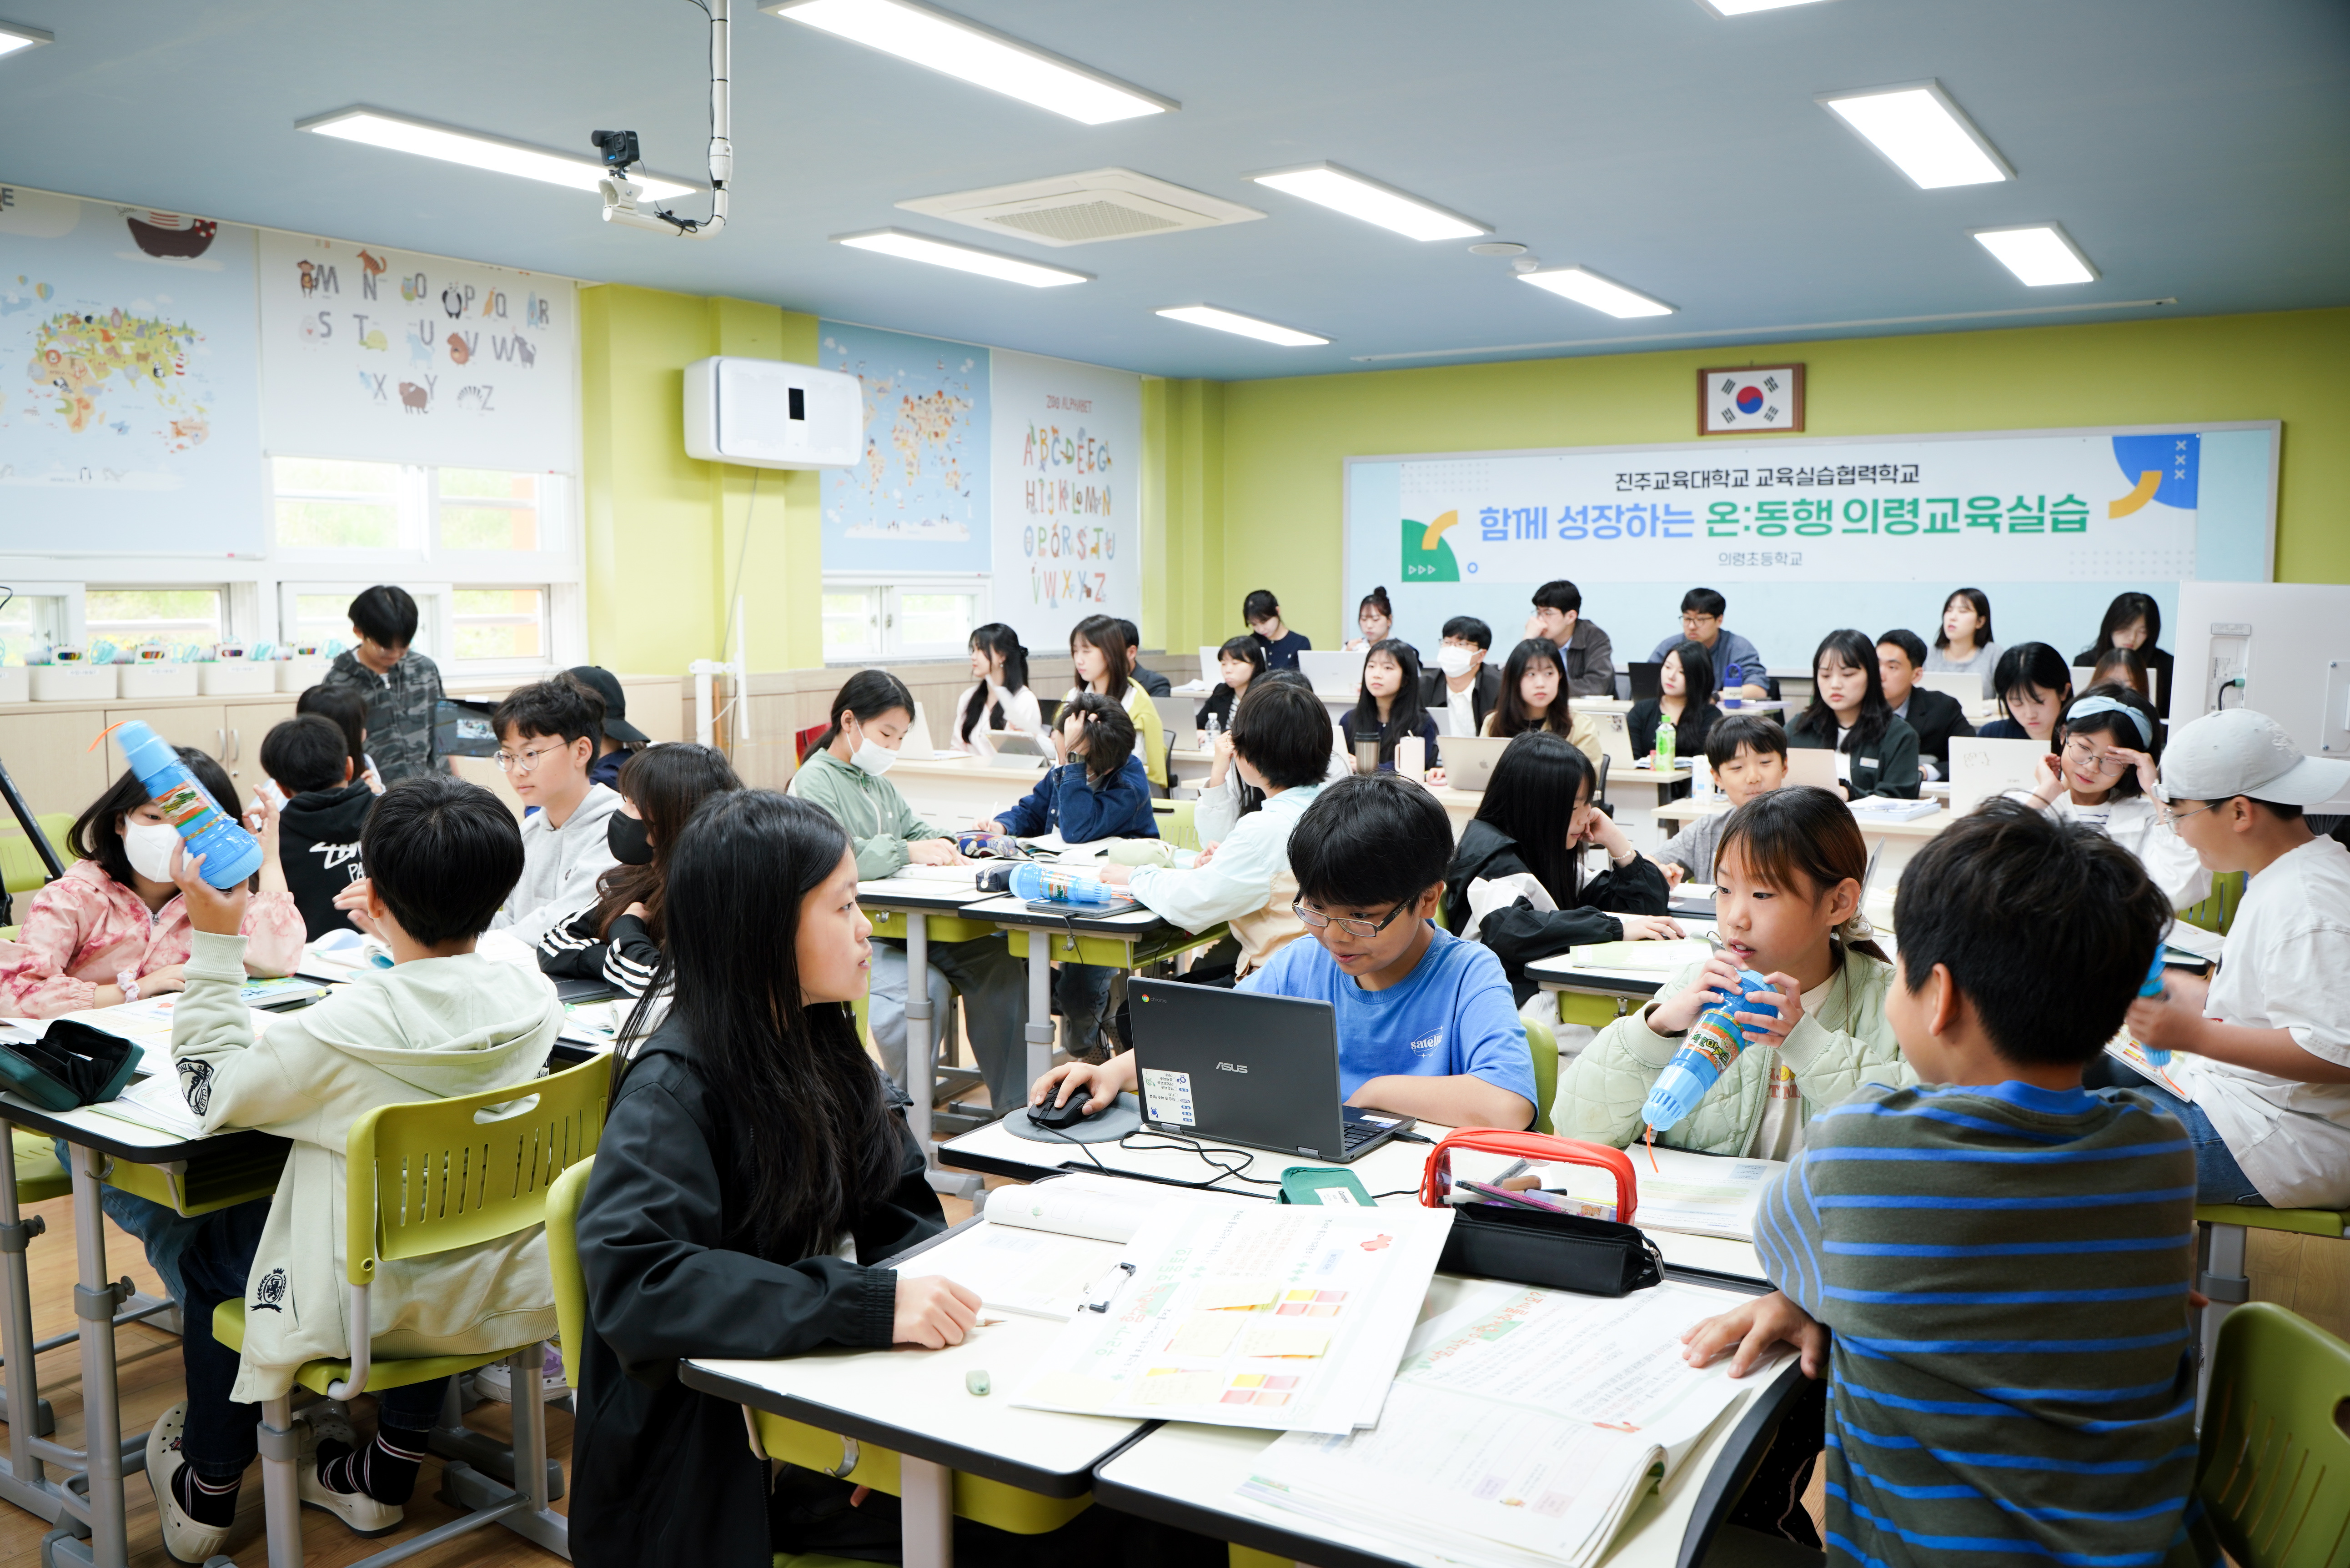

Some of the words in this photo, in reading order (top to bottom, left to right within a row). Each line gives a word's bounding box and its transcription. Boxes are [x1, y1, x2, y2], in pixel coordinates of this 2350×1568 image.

[2, 188, 14, 207] E
[314, 265, 340, 294] M
[364, 272, 377, 301] N
[465, 285, 476, 310] P
[496, 293, 508, 318] Q
[539, 299, 549, 324] R
[318, 312, 332, 338] S
[353, 314, 369, 341] T
[420, 320, 434, 346] U
[465, 331, 479, 357] V
[492, 335, 516, 362] W
[373, 373, 387, 401] X
[425, 374, 438, 400] Y
[481, 385, 495, 411] Z
[1615, 468, 1750, 492] 진주교육대학교
[1756, 463, 1920, 488] 교육실습협력학교
[1479, 506, 1547, 541] 함께
[1557, 503, 1695, 540] 성장하는
[1706, 498, 1833, 537] 온:동행
[1842, 493, 2090, 536] 의령교육실습
[1718, 552, 1803, 567] 의령초등학교
[1215, 1061, 1248, 1074] ASUS
[1338, 1191, 1350, 1203] Campus
[1095, 1326, 1127, 1355] 우리가
[1120, 1287, 1165, 1321] 함께하는
[1157, 1247, 1193, 1280] 모둠토의
[1428, 1339, 1475, 1361] 사회자는
